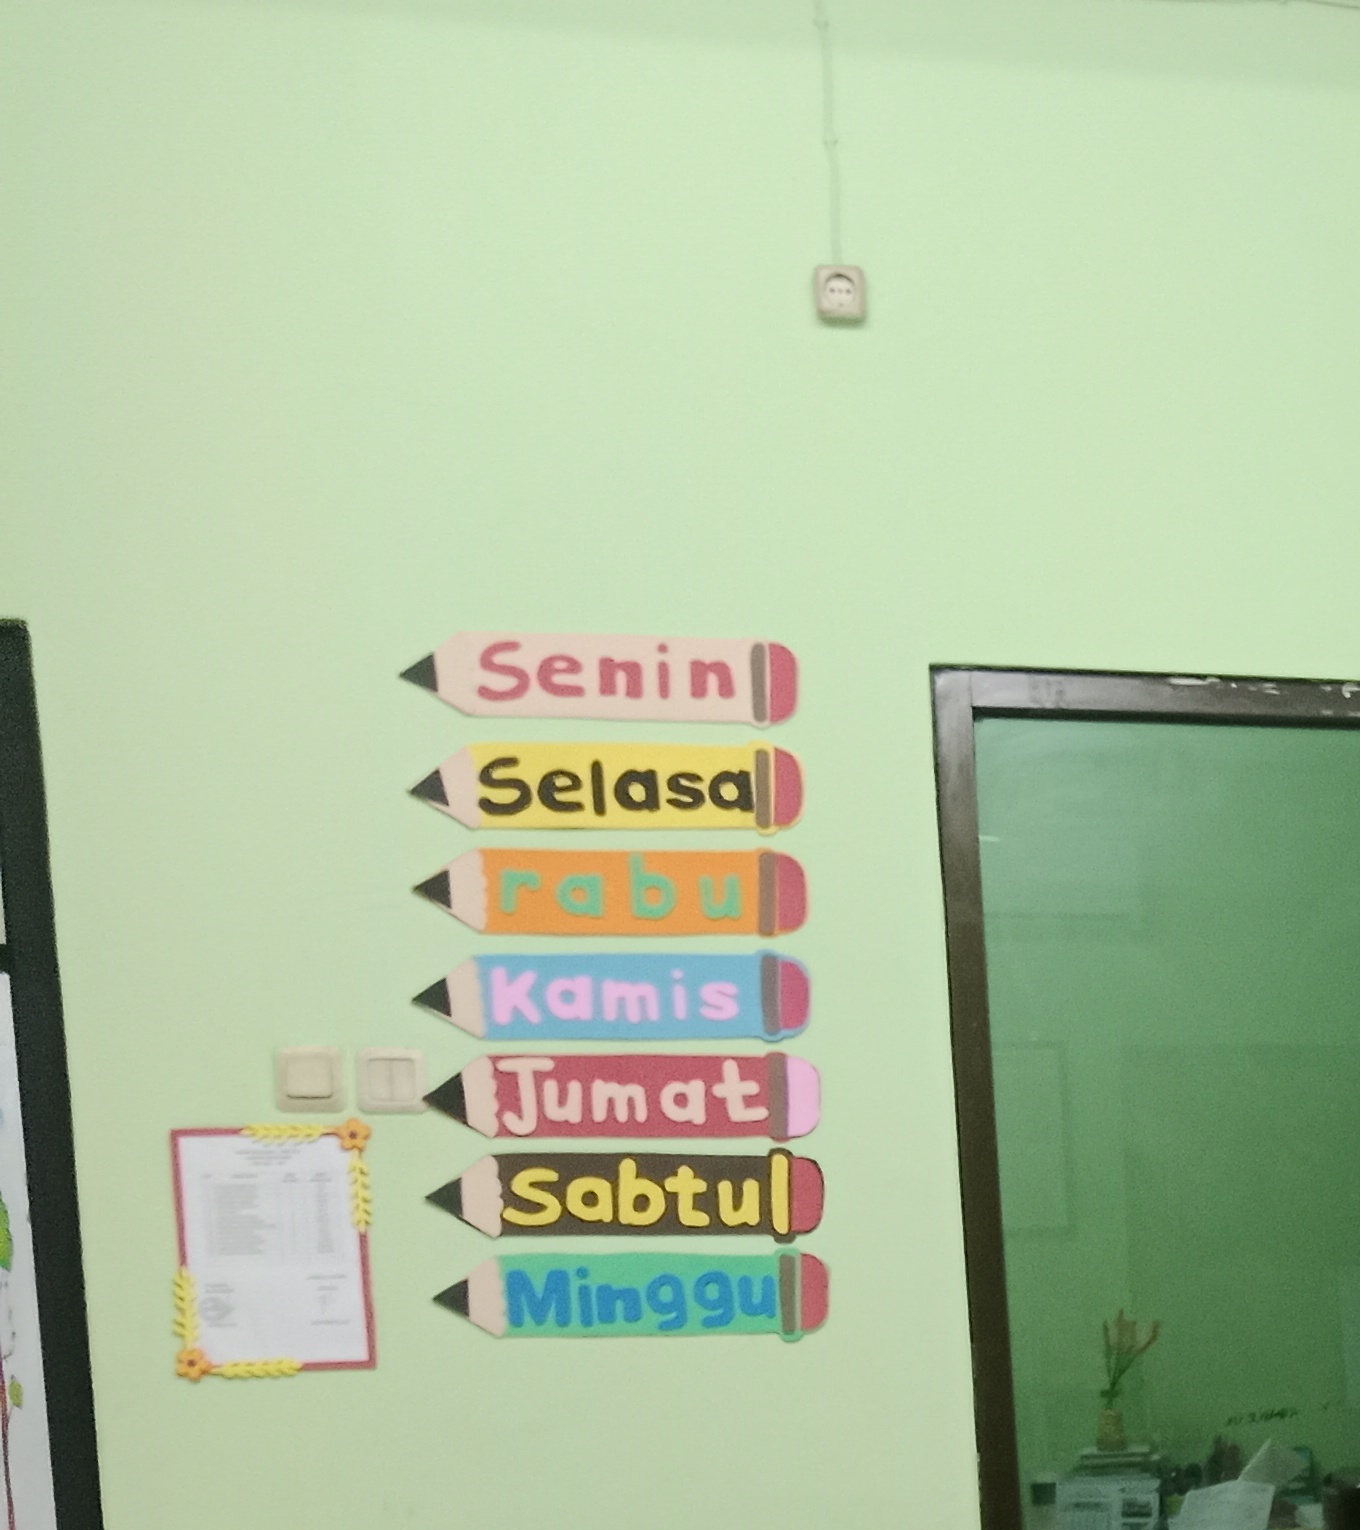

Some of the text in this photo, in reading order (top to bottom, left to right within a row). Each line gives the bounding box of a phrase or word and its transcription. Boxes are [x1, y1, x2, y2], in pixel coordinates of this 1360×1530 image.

[476, 640, 736, 701] Senin
[477, 757, 755, 816] Selasa
[500, 852, 743, 920] rabu
[489, 966, 741, 1025] Kamis
[496, 1057, 770, 1136] Jumat
[505, 1266, 777, 1332] Minggu
